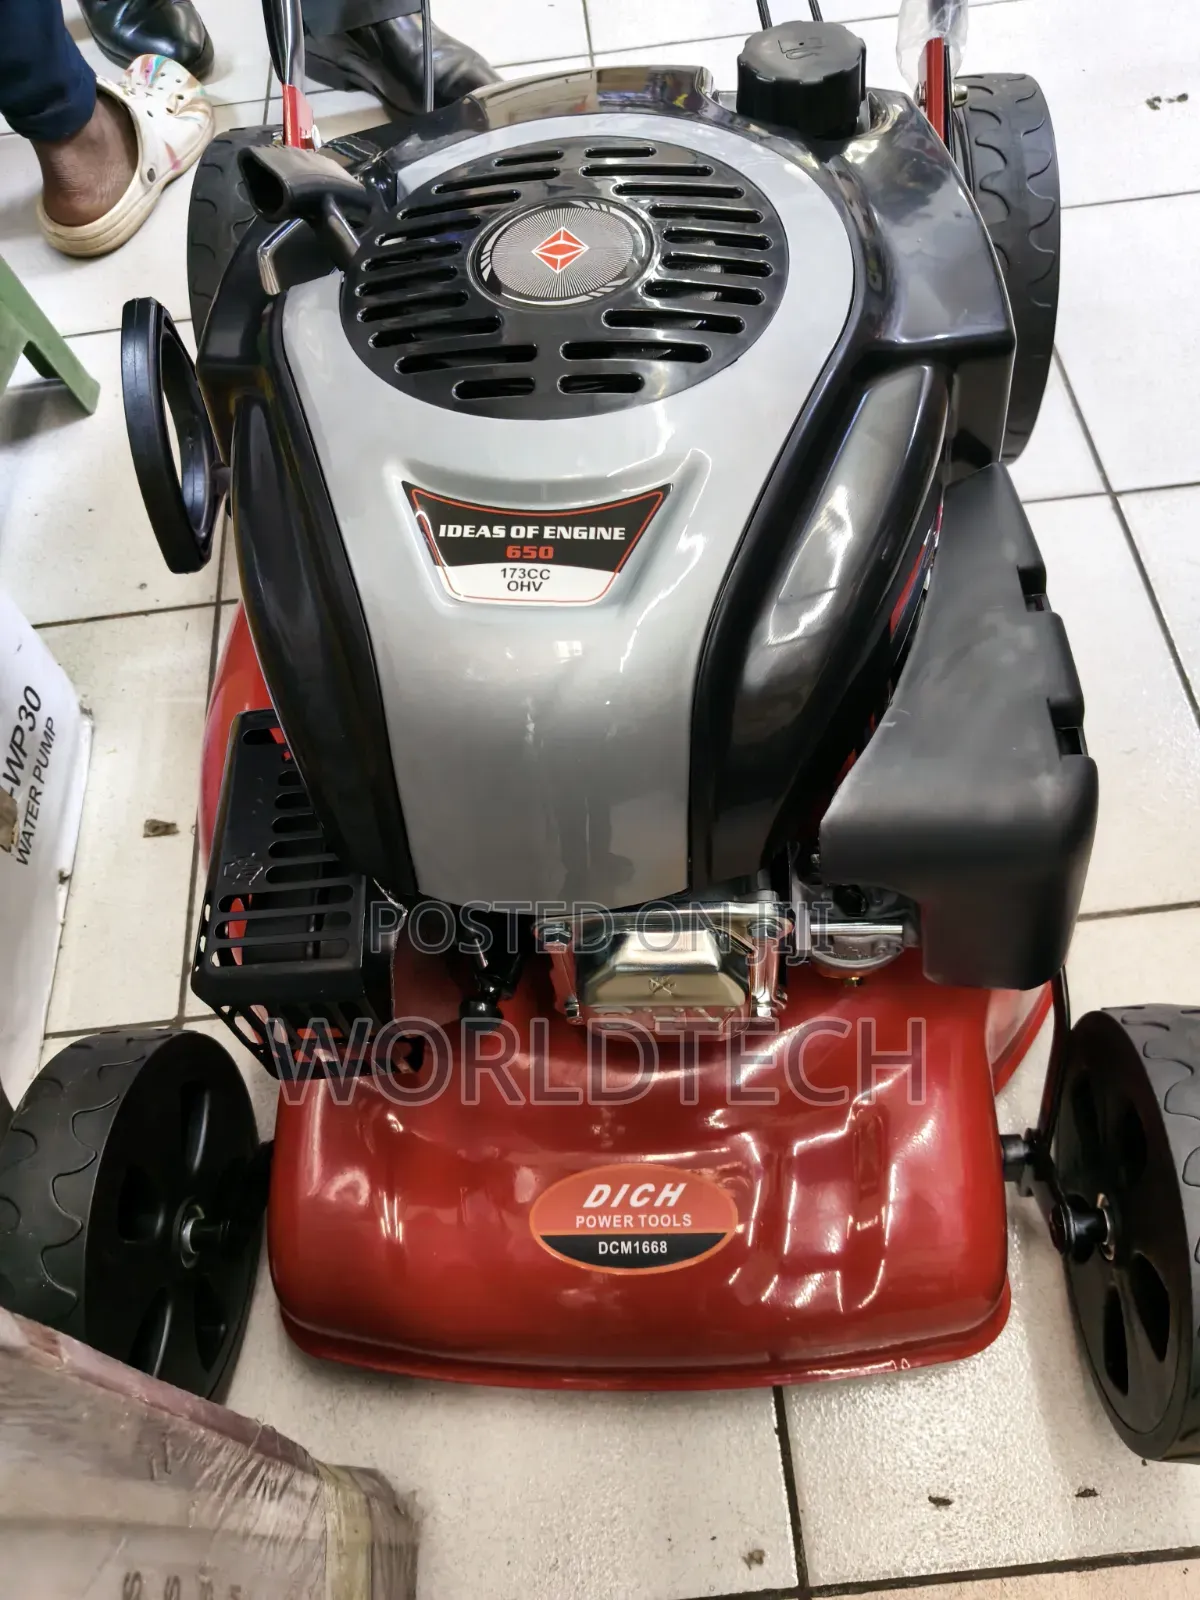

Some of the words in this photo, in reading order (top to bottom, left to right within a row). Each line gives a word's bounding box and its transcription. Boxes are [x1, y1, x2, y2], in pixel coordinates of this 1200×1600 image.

[438, 524, 506, 538] IDEAS
[510, 525, 540, 539] OF
[543, 526, 626, 541] ENGINE
[506, 545, 554, 560] 650
[500, 568, 551, 581] 173CC
[507, 581, 544, 592] OHV
[16, 784, 43, 866] WATER
[32, 716, 56, 785] PUMP
[583, 1182, 687, 1209] DICH
[575, 1215, 634, 1228] POWER
[638, 1213, 692, 1227] TOOLS
[598, 1241, 668, 1255] DCM1668
